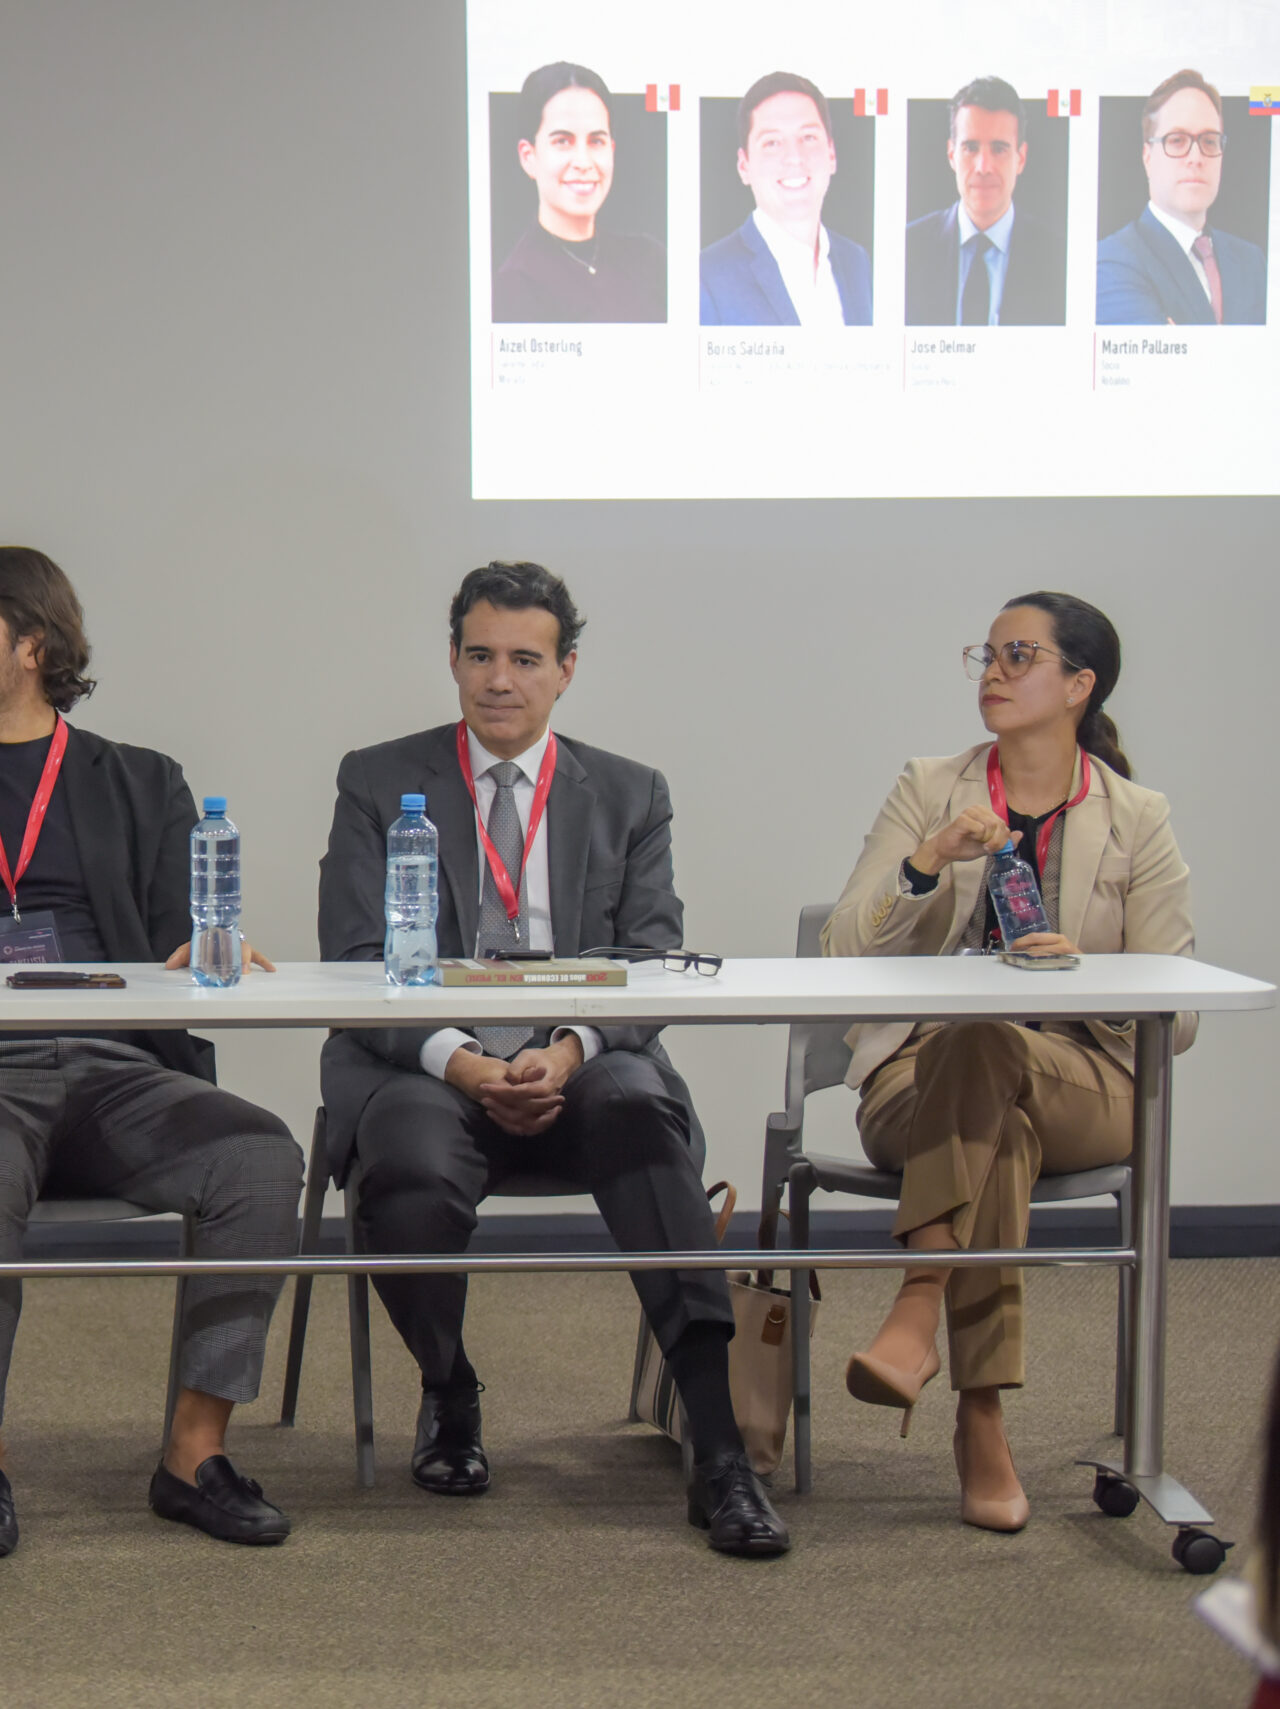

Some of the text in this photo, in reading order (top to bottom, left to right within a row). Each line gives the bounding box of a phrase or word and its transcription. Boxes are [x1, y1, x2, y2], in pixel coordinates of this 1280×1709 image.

[530, 338, 583, 357] Osterling
[707, 341, 737, 356] Boris
[939, 339, 977, 353] Delmar
[1141, 339, 1188, 354] Pallares
